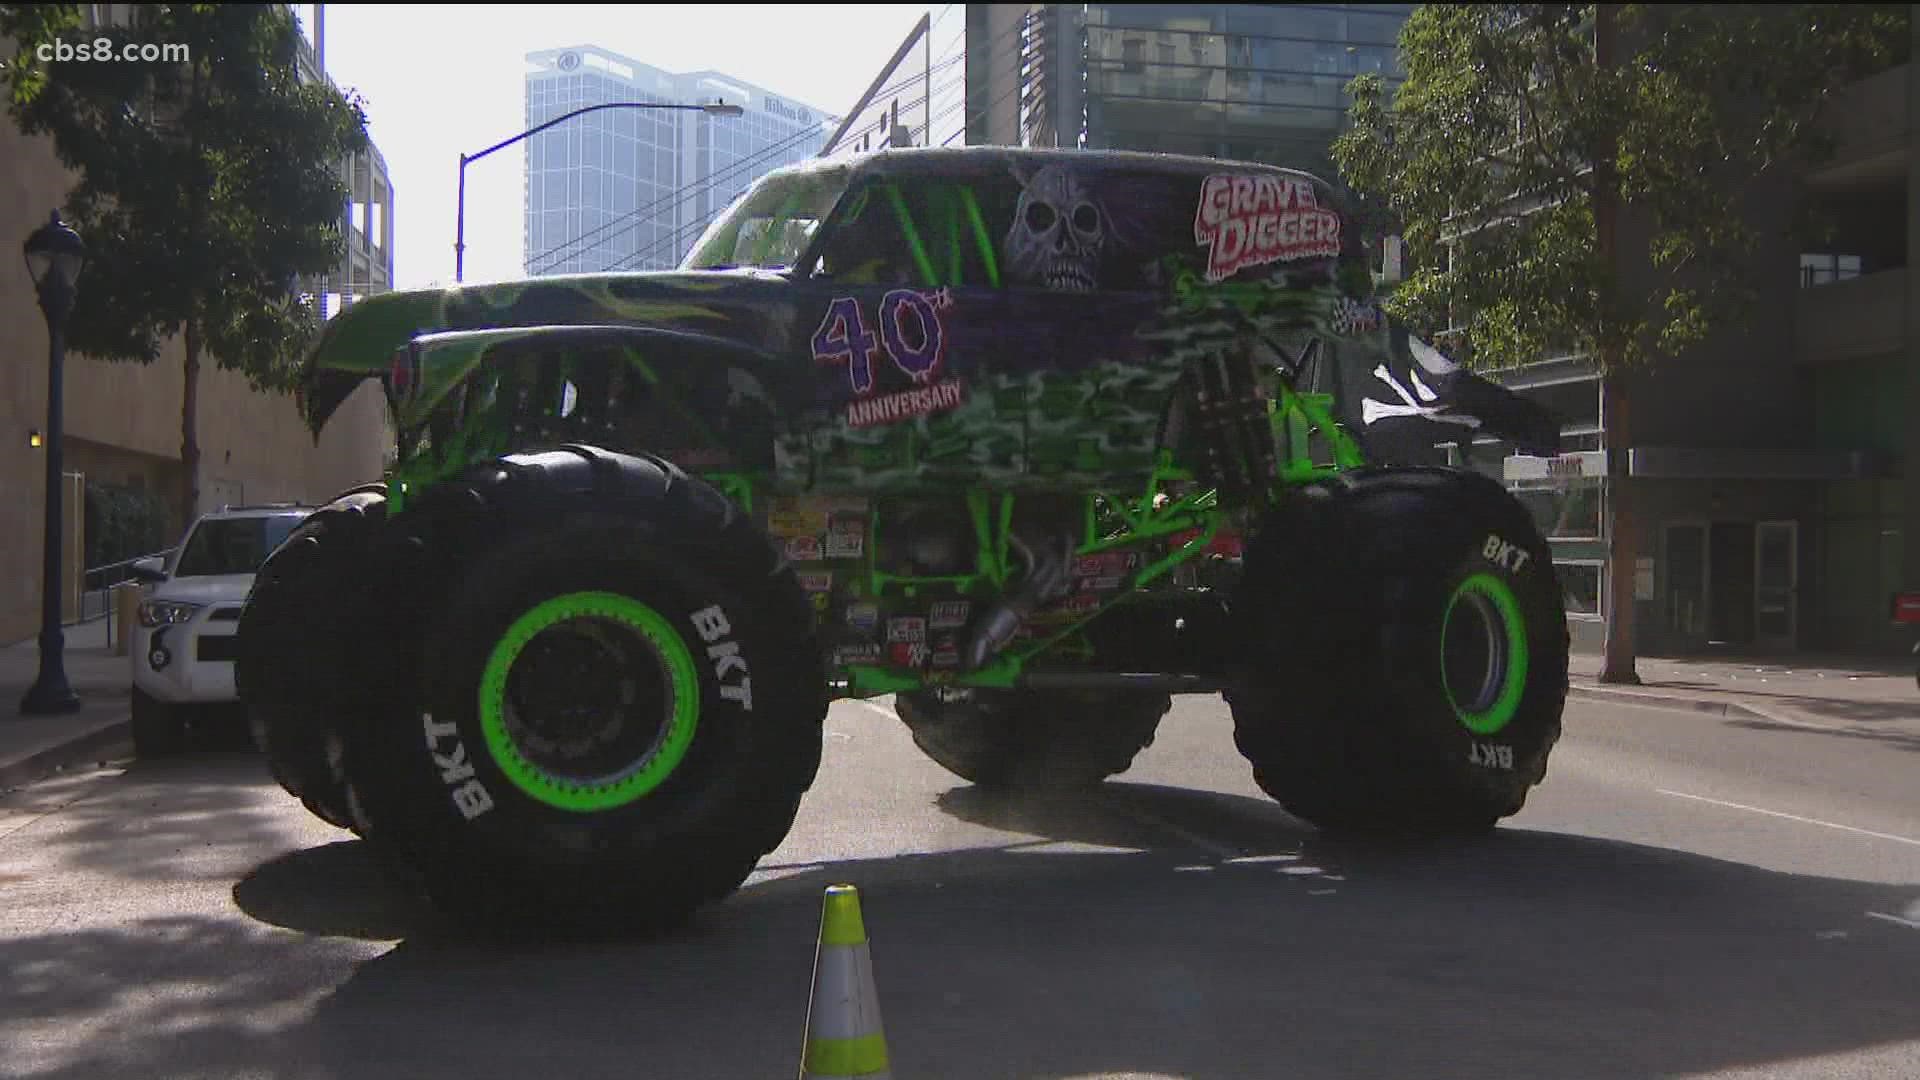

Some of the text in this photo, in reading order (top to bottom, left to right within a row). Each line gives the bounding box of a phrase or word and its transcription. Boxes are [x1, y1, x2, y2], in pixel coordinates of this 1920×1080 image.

[1201, 175, 1315, 226] GRAVE
[1212, 210, 1339, 265] DIGGER
[848, 380, 961, 426] ANNIVERSARY
[1483, 533, 1530, 574] BKT
[689, 603, 753, 712] BKT
[423, 712, 494, 821] BKT
[1468, 742, 1514, 769] BKT
